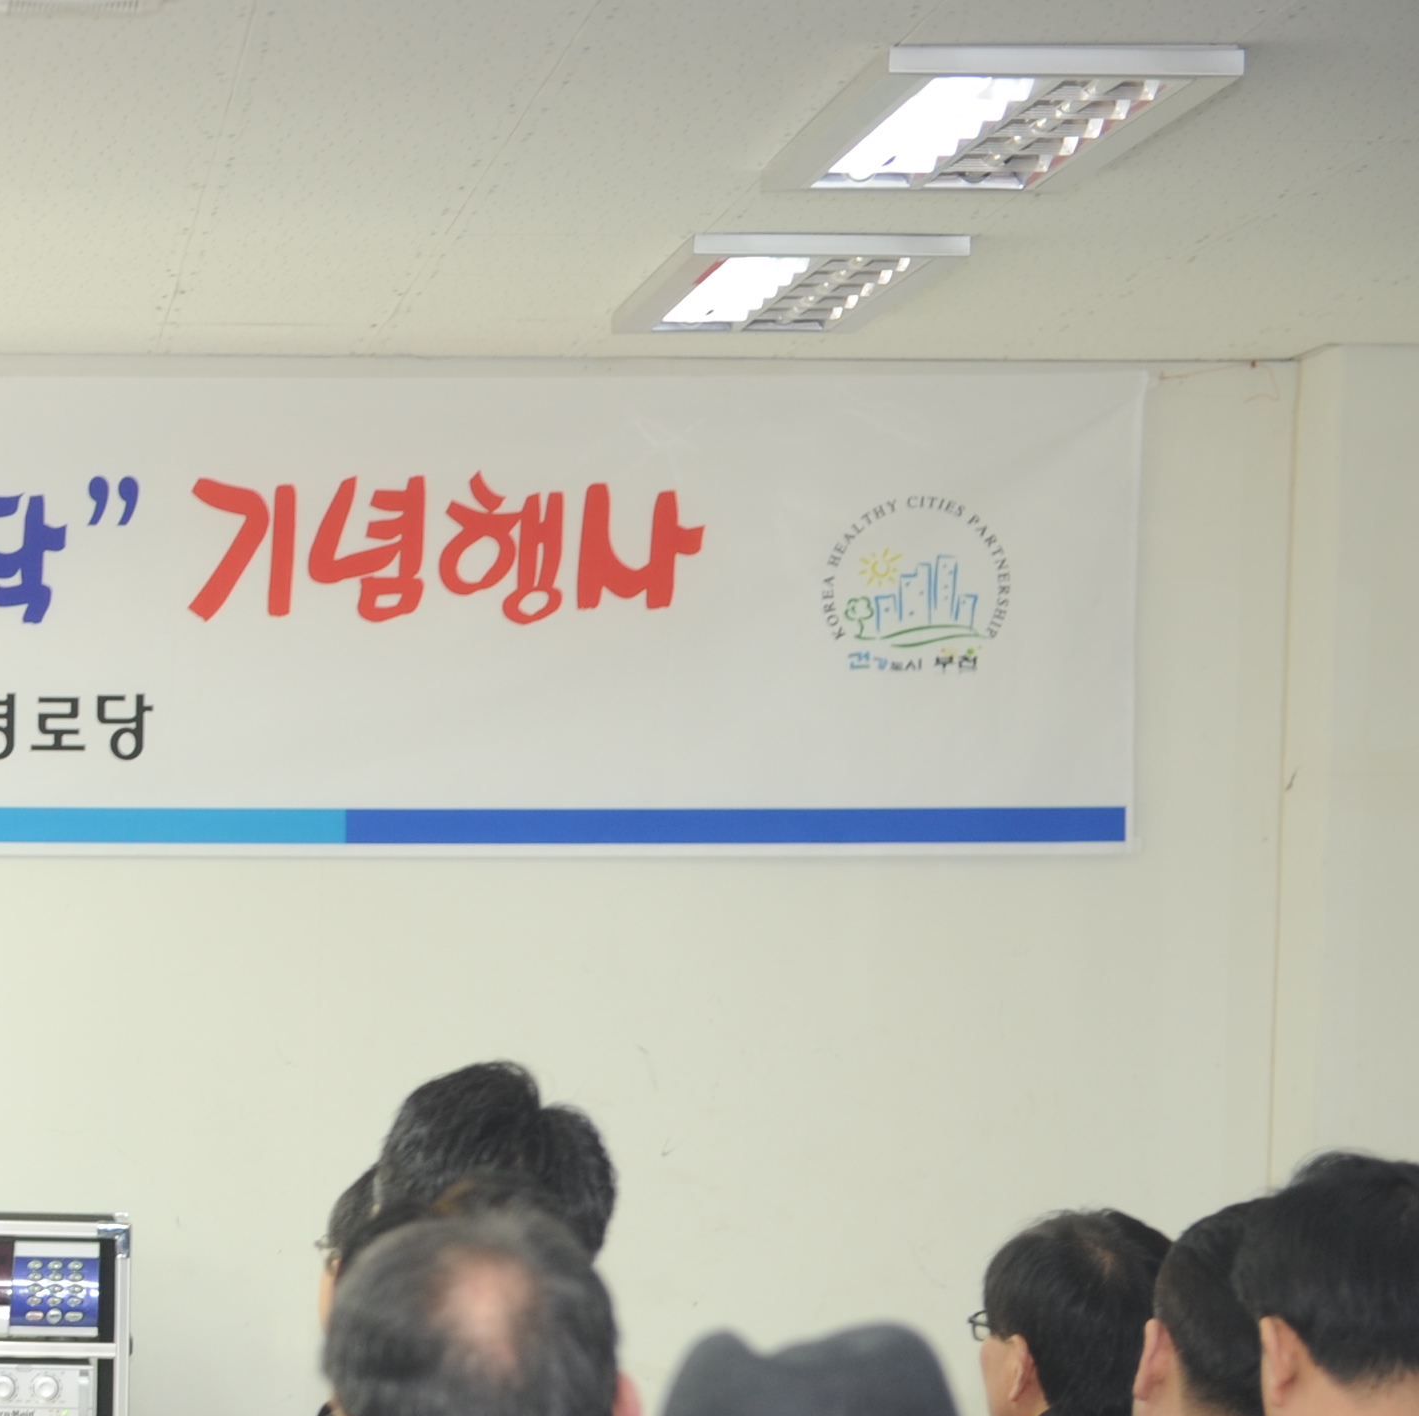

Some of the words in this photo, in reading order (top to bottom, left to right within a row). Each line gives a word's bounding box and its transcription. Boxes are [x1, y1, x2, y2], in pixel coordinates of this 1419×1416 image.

[827, 499, 898, 567] HEALTHY
[906, 495, 966, 518] CITIES
[187, 470, 707, 627] 기념행사
[967, 513, 1011, 639] PARTNERSHIP
[821, 575, 846, 641] KOREA
